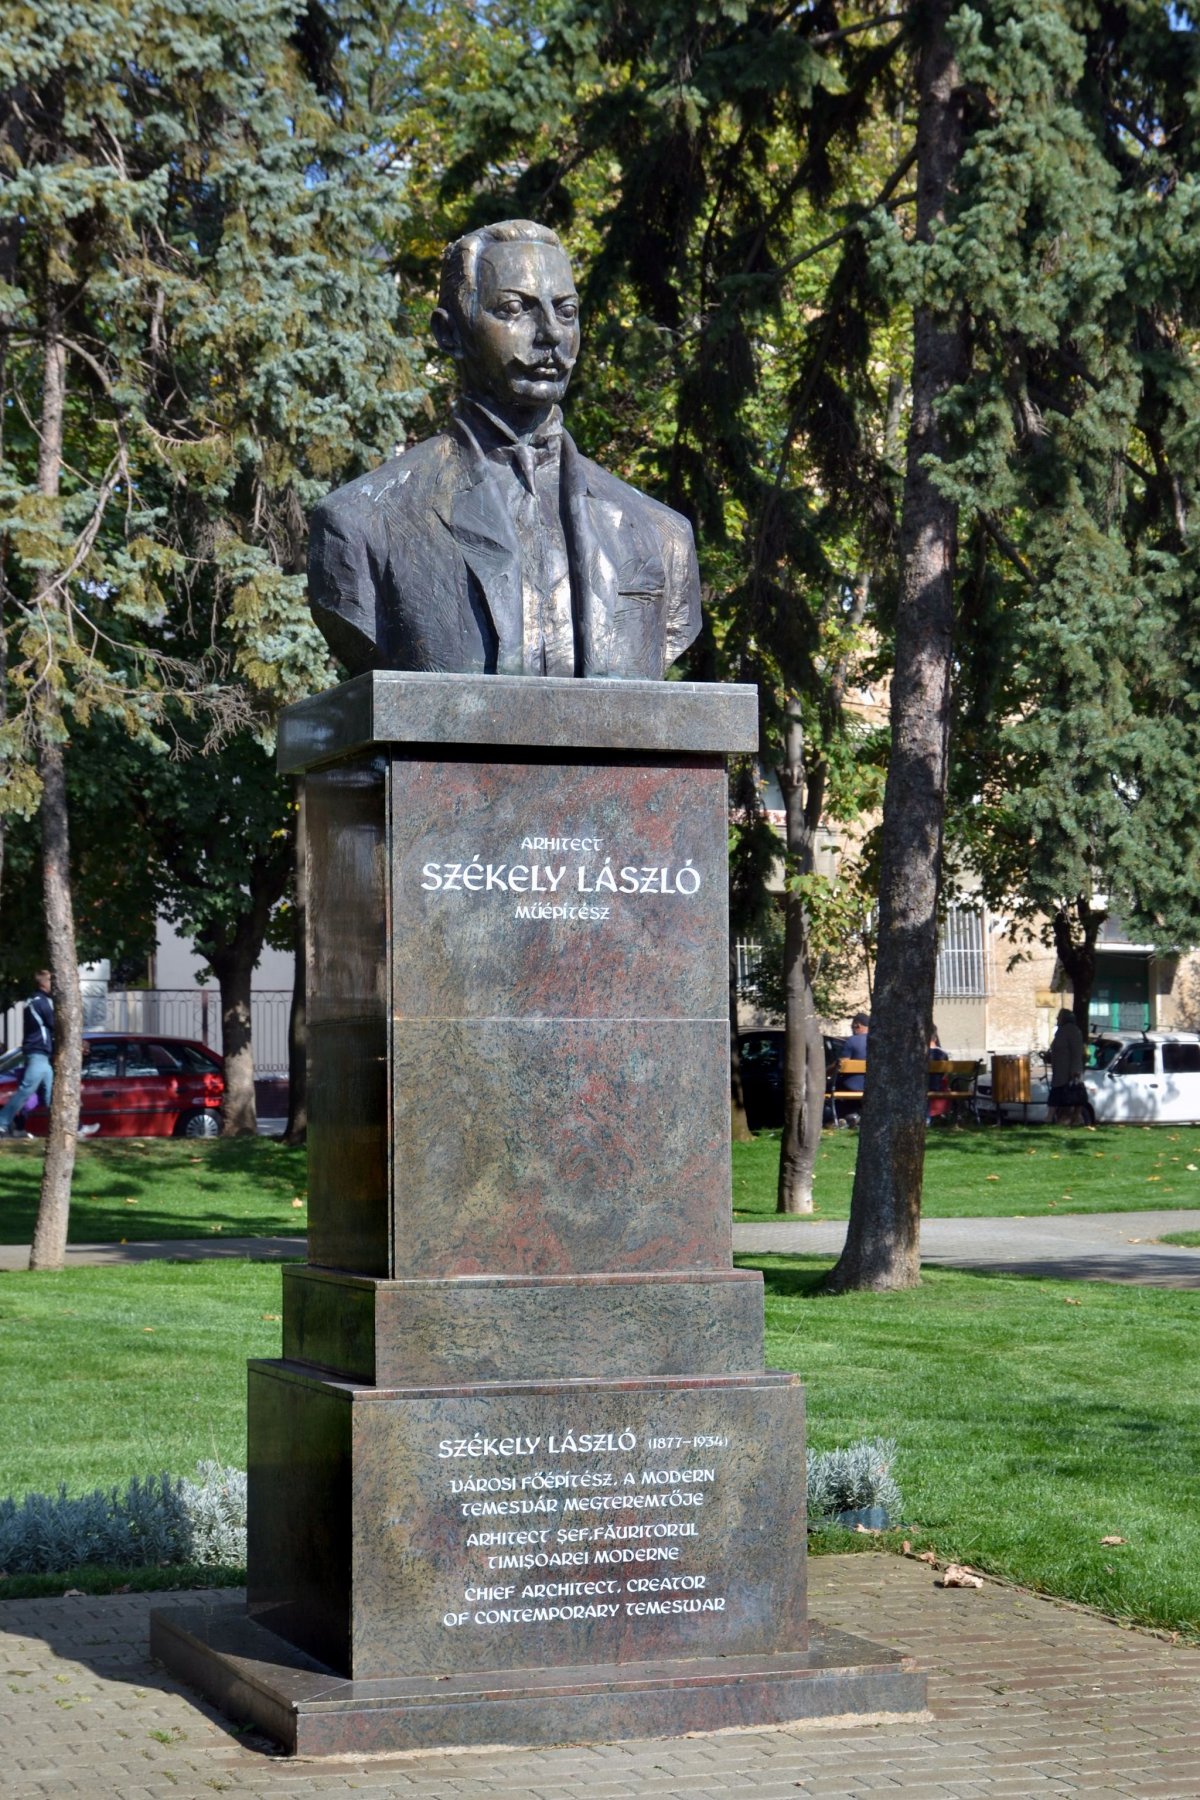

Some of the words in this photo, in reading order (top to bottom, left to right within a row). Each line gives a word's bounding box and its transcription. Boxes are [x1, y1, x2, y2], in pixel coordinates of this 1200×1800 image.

[521, 837, 604, 851] ARHITECT
[421, 854, 567, 892] SZÉKELY
[579, 857, 701, 895] LÁSZLÓ
[515, 902, 611, 920] MŰÉPÍTÉSZ
[438, 1433, 541, 1458] SZÉKELY
[549, 1427, 637, 1454] LÁSZLÓ
[450, 1475, 516, 1493] VÁROSI
[624, 1472, 636, 1485] A
[641, 1469, 715, 1485] MODERN
[461, 1495, 558, 1516] TEMESVÁR
[564, 1489, 704, 1511] MEGTEREMTŐJE
[466, 1530, 550, 1547] ARHITECT
[594, 1547, 680, 1564] MODERNE
[464, 1585, 515, 1602] CHIEF
[626, 1575, 706, 1593] CREATOR
[443, 1612, 470, 1626] OF
[474, 1603, 620, 1624] CONTEMPORARY
[626, 1598, 726, 1616] TEMESWAR
